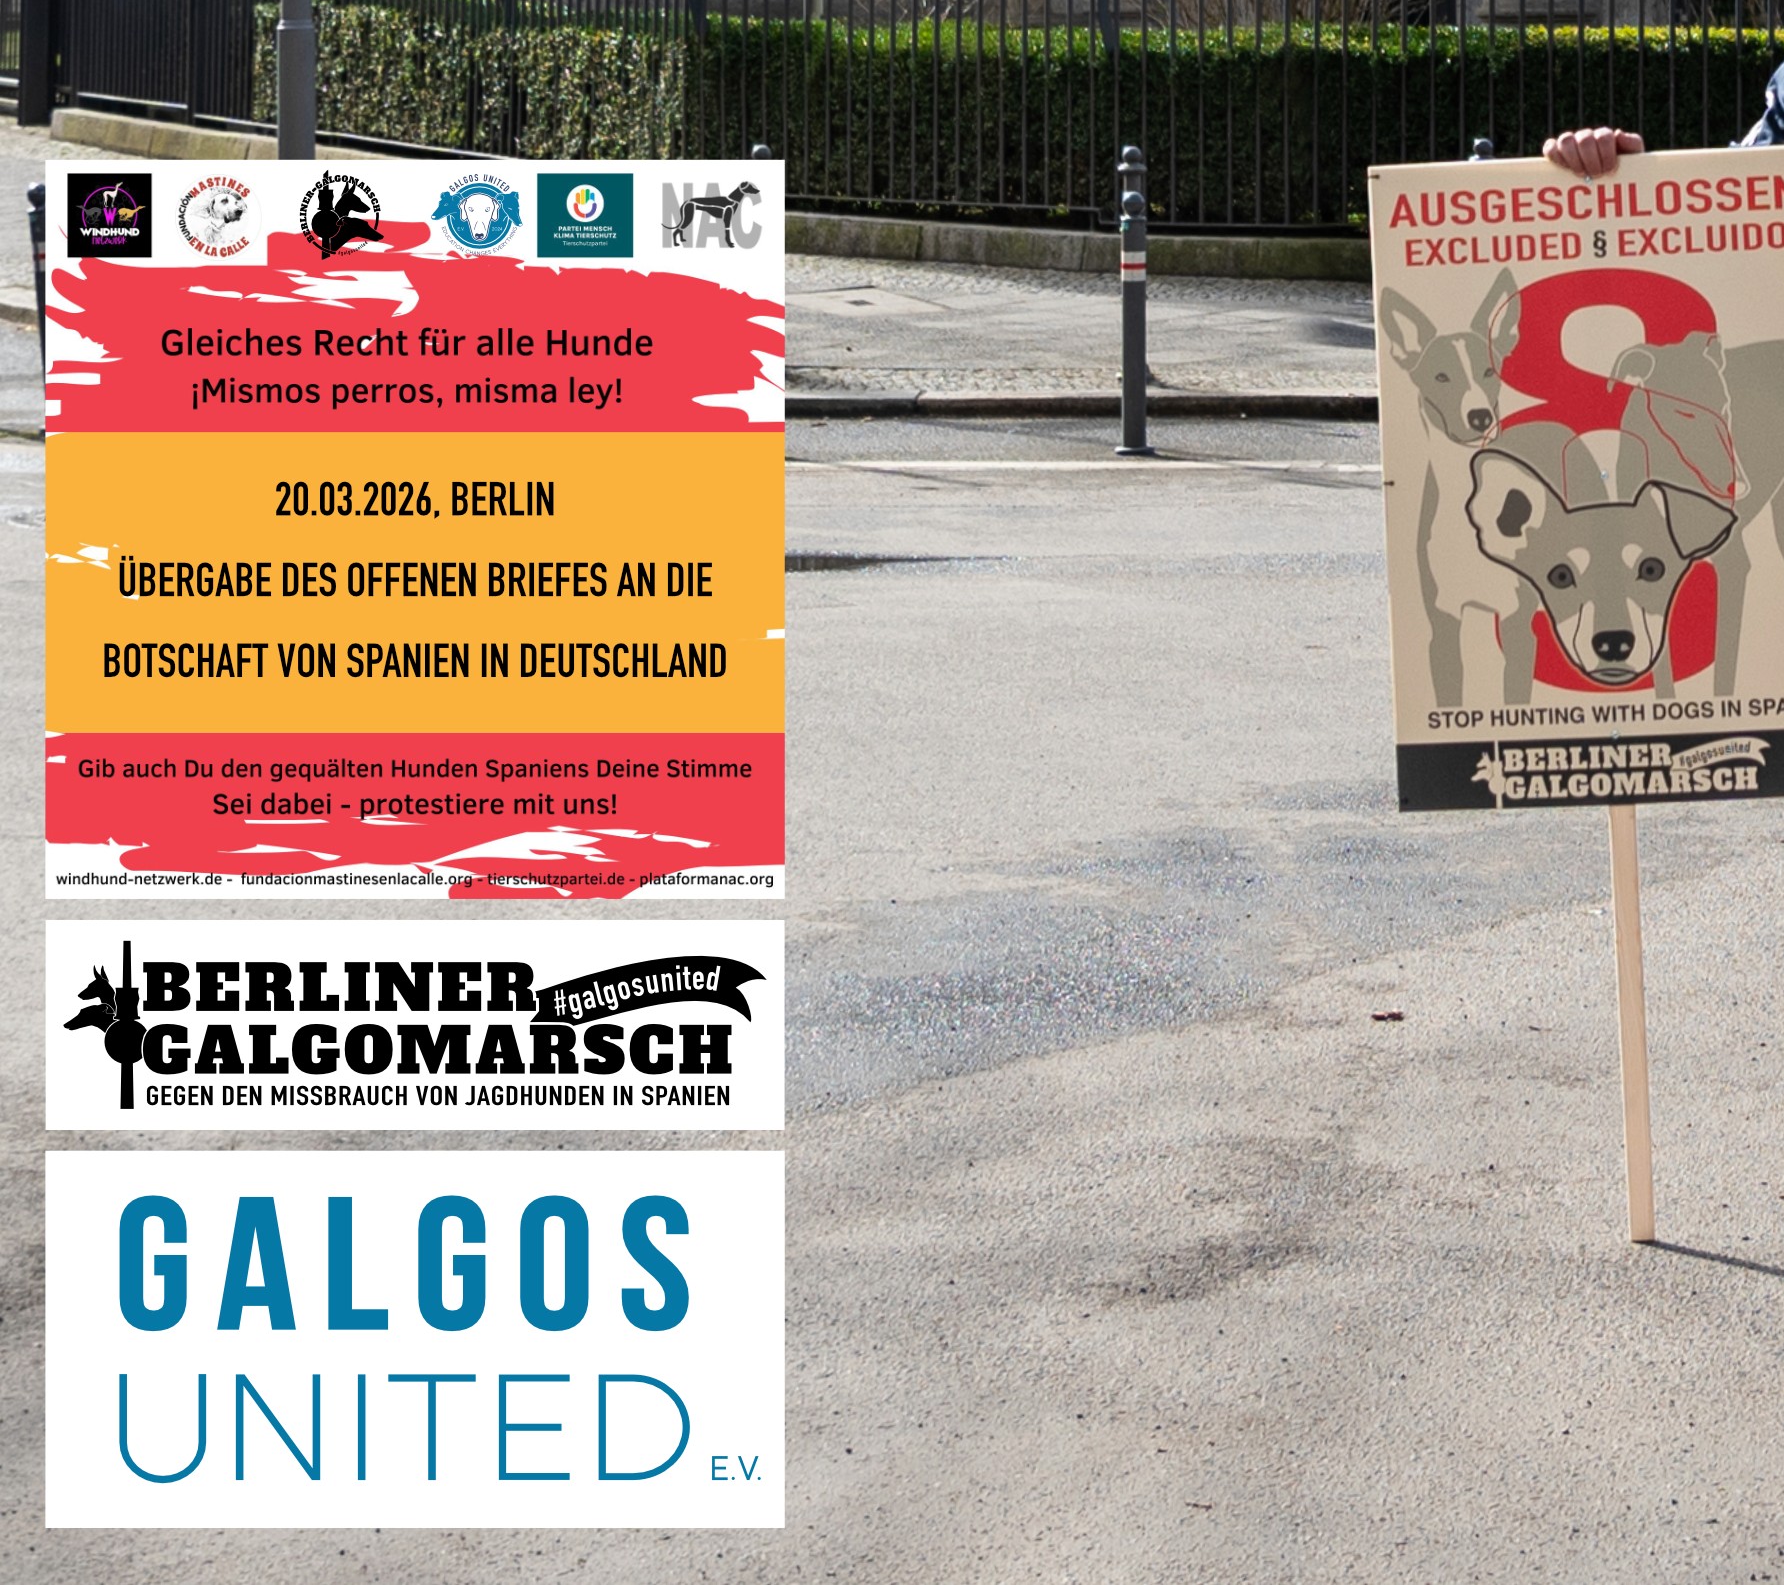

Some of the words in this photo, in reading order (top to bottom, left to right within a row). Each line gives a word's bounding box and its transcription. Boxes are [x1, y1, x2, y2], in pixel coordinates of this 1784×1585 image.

[1405, 232, 1582, 267] EXCLUDED
[1592, 230, 1608, 259] §
[1428, 710, 1484, 729] STOP
[1490, 707, 1585, 727] HUNTING
[1590, 704, 1645, 724] WITH
[1653, 701, 1715, 721] DOGS
[1721, 698, 1741, 718] IN
[1503, 742, 1673, 773] BERLINER
[1679, 741, 1752, 769] #galgosunited
[1504, 766, 1759, 799] GALGOMARSCH
